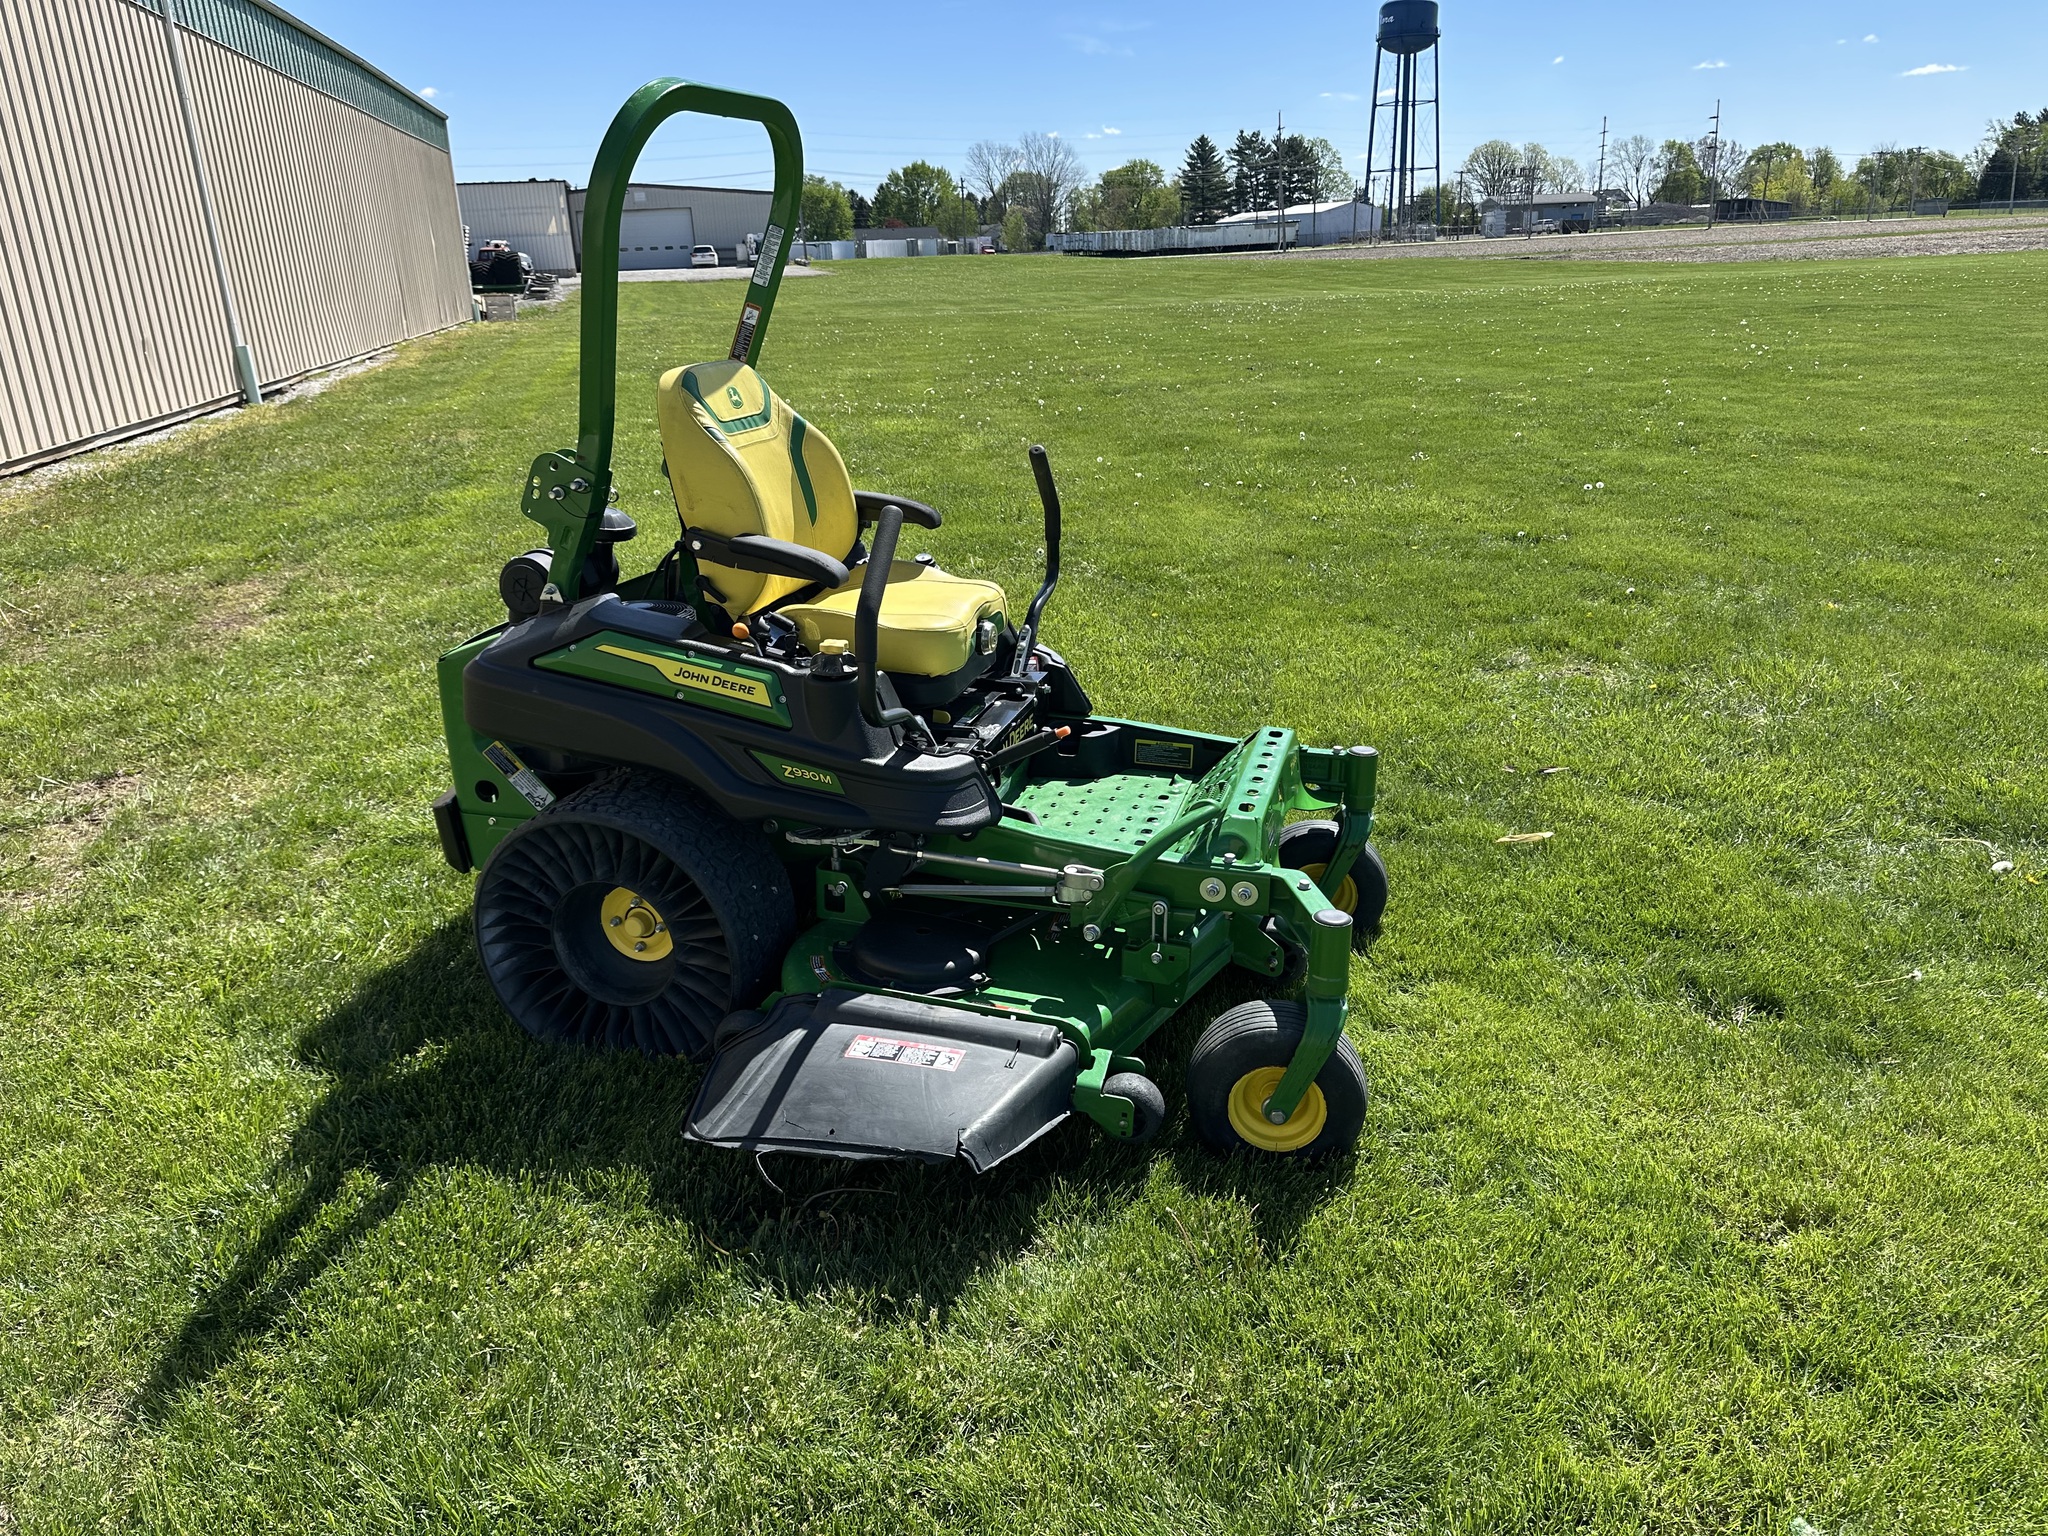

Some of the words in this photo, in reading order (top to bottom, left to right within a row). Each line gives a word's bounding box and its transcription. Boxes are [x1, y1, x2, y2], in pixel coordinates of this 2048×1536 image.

[674, 667, 710, 684] JOHN
[711, 675, 756, 696] DEERE
[1009, 713, 1034, 747] DEERE
[781, 764, 832, 785] Z930M
